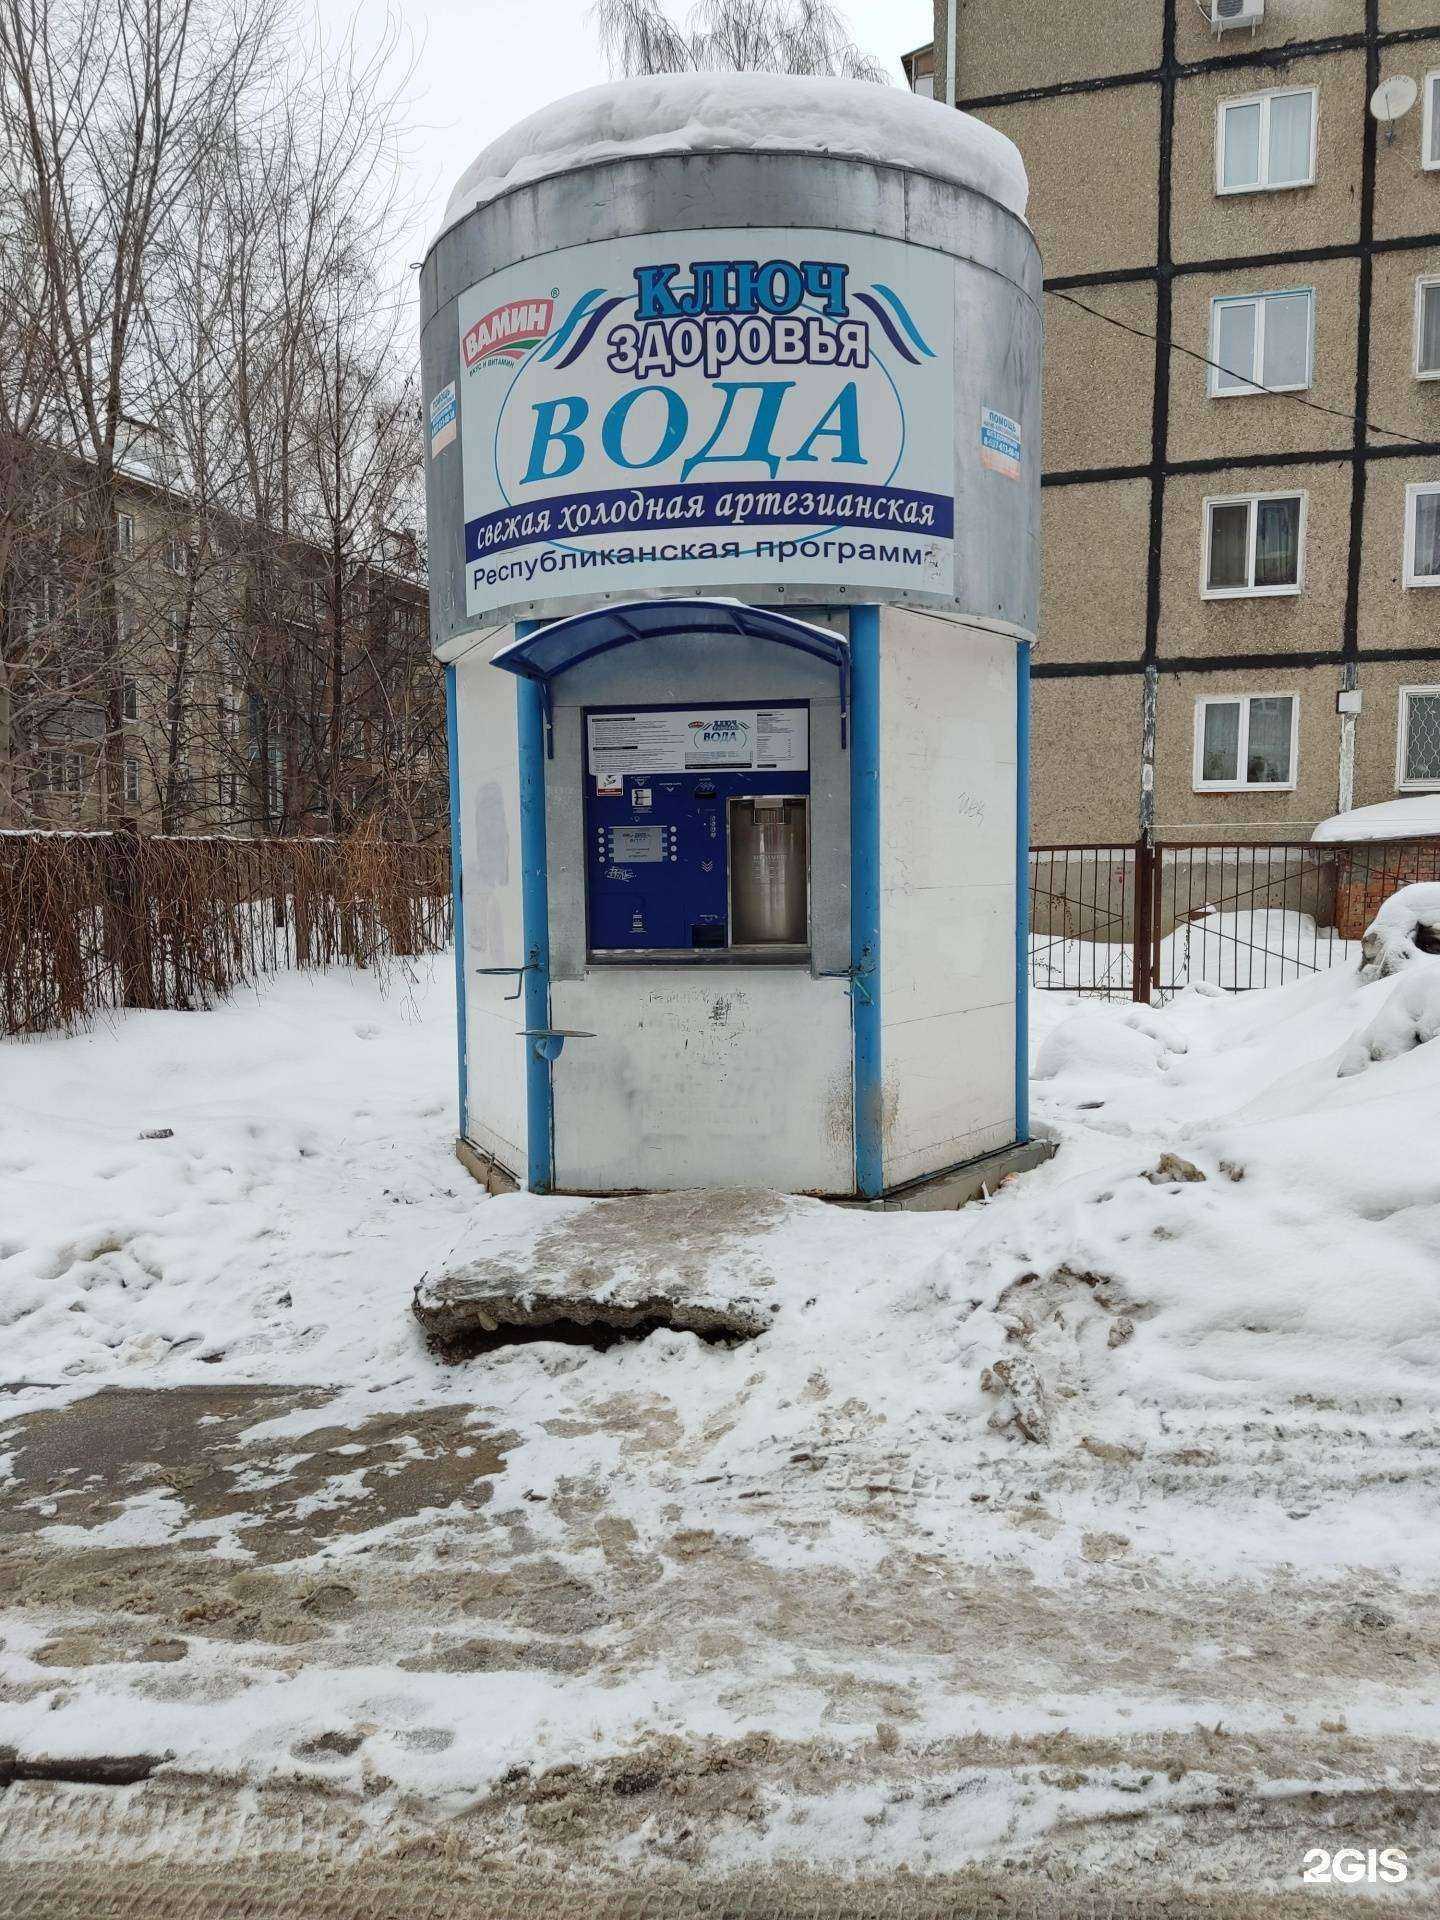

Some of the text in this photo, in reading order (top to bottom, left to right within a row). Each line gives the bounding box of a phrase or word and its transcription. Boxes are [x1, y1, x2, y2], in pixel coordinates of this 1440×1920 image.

[633, 259, 850, 321] КЛЮЧ
[465, 303, 548, 362] ВАМИН
[519, 381, 869, 485] ВОДА
[477, 490, 935, 550] свежая холодная артезианская
[474, 541, 933, 590] Республиканская программ
